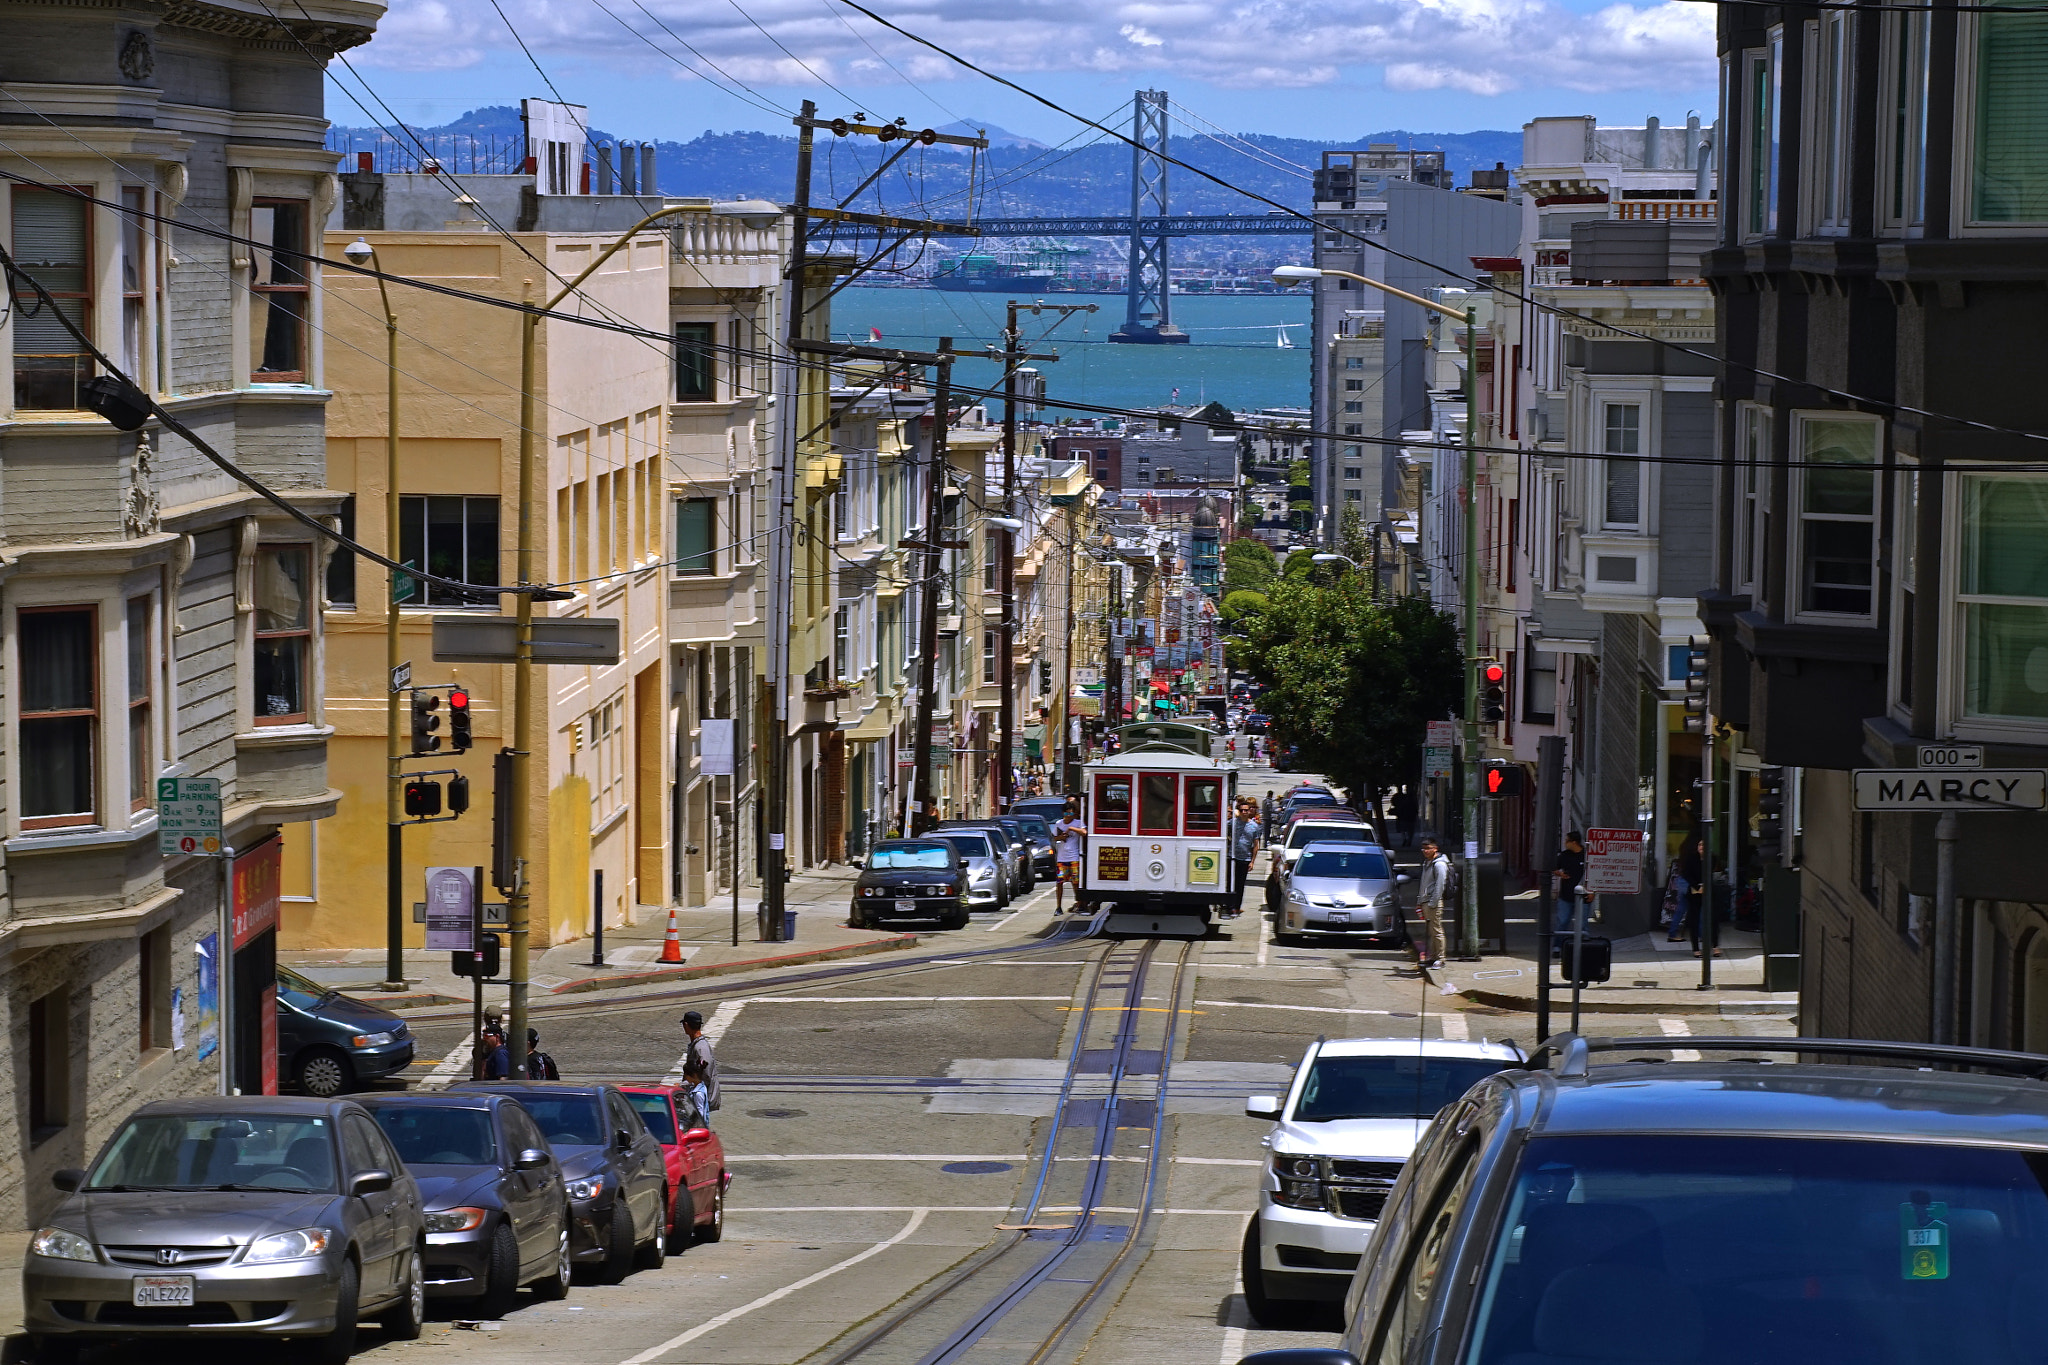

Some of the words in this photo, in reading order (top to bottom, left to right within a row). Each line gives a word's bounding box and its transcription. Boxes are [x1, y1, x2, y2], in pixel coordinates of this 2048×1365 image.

[1923, 750, 1959, 765] 000
[162, 782, 174, 798] 2
[1879, 779, 2021, 801] MARCY
[163, 804, 170, 816] 8
[197, 804, 204, 816] 9
[1592, 831, 1612, 839] TOW
[1613, 832, 1639, 840] AWAY
[184, 839, 192, 850] A
[208, 839, 215, 850] C
[1151, 844, 1162, 854] 9
[1588, 840, 1606, 853] NO
[1608, 842, 1639, 852] STOPPING
[138, 1287, 190, 1302] 6HLE222
